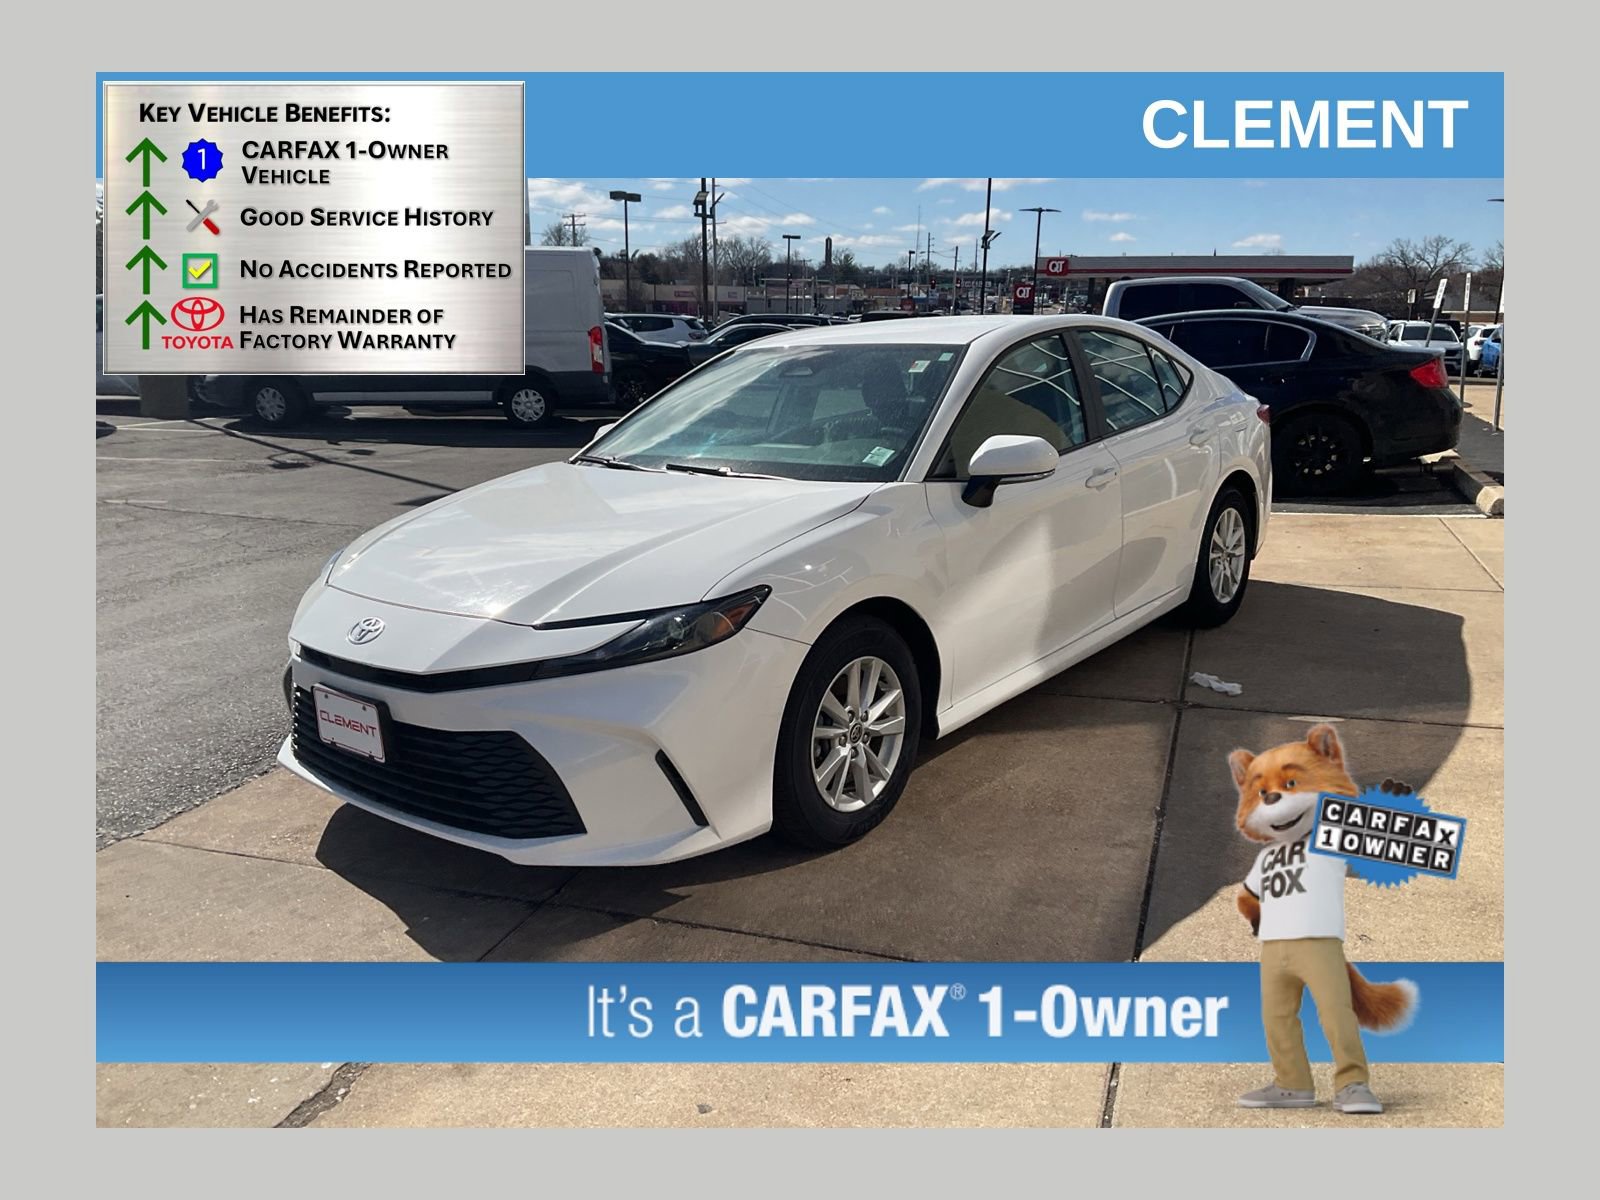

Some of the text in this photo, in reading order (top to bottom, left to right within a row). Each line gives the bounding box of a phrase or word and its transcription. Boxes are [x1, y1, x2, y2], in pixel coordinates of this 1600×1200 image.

[1048, 260, 1065, 274] QT
[1016, 286, 1032, 299] QT
[319, 709, 377, 737] CLEMENT
